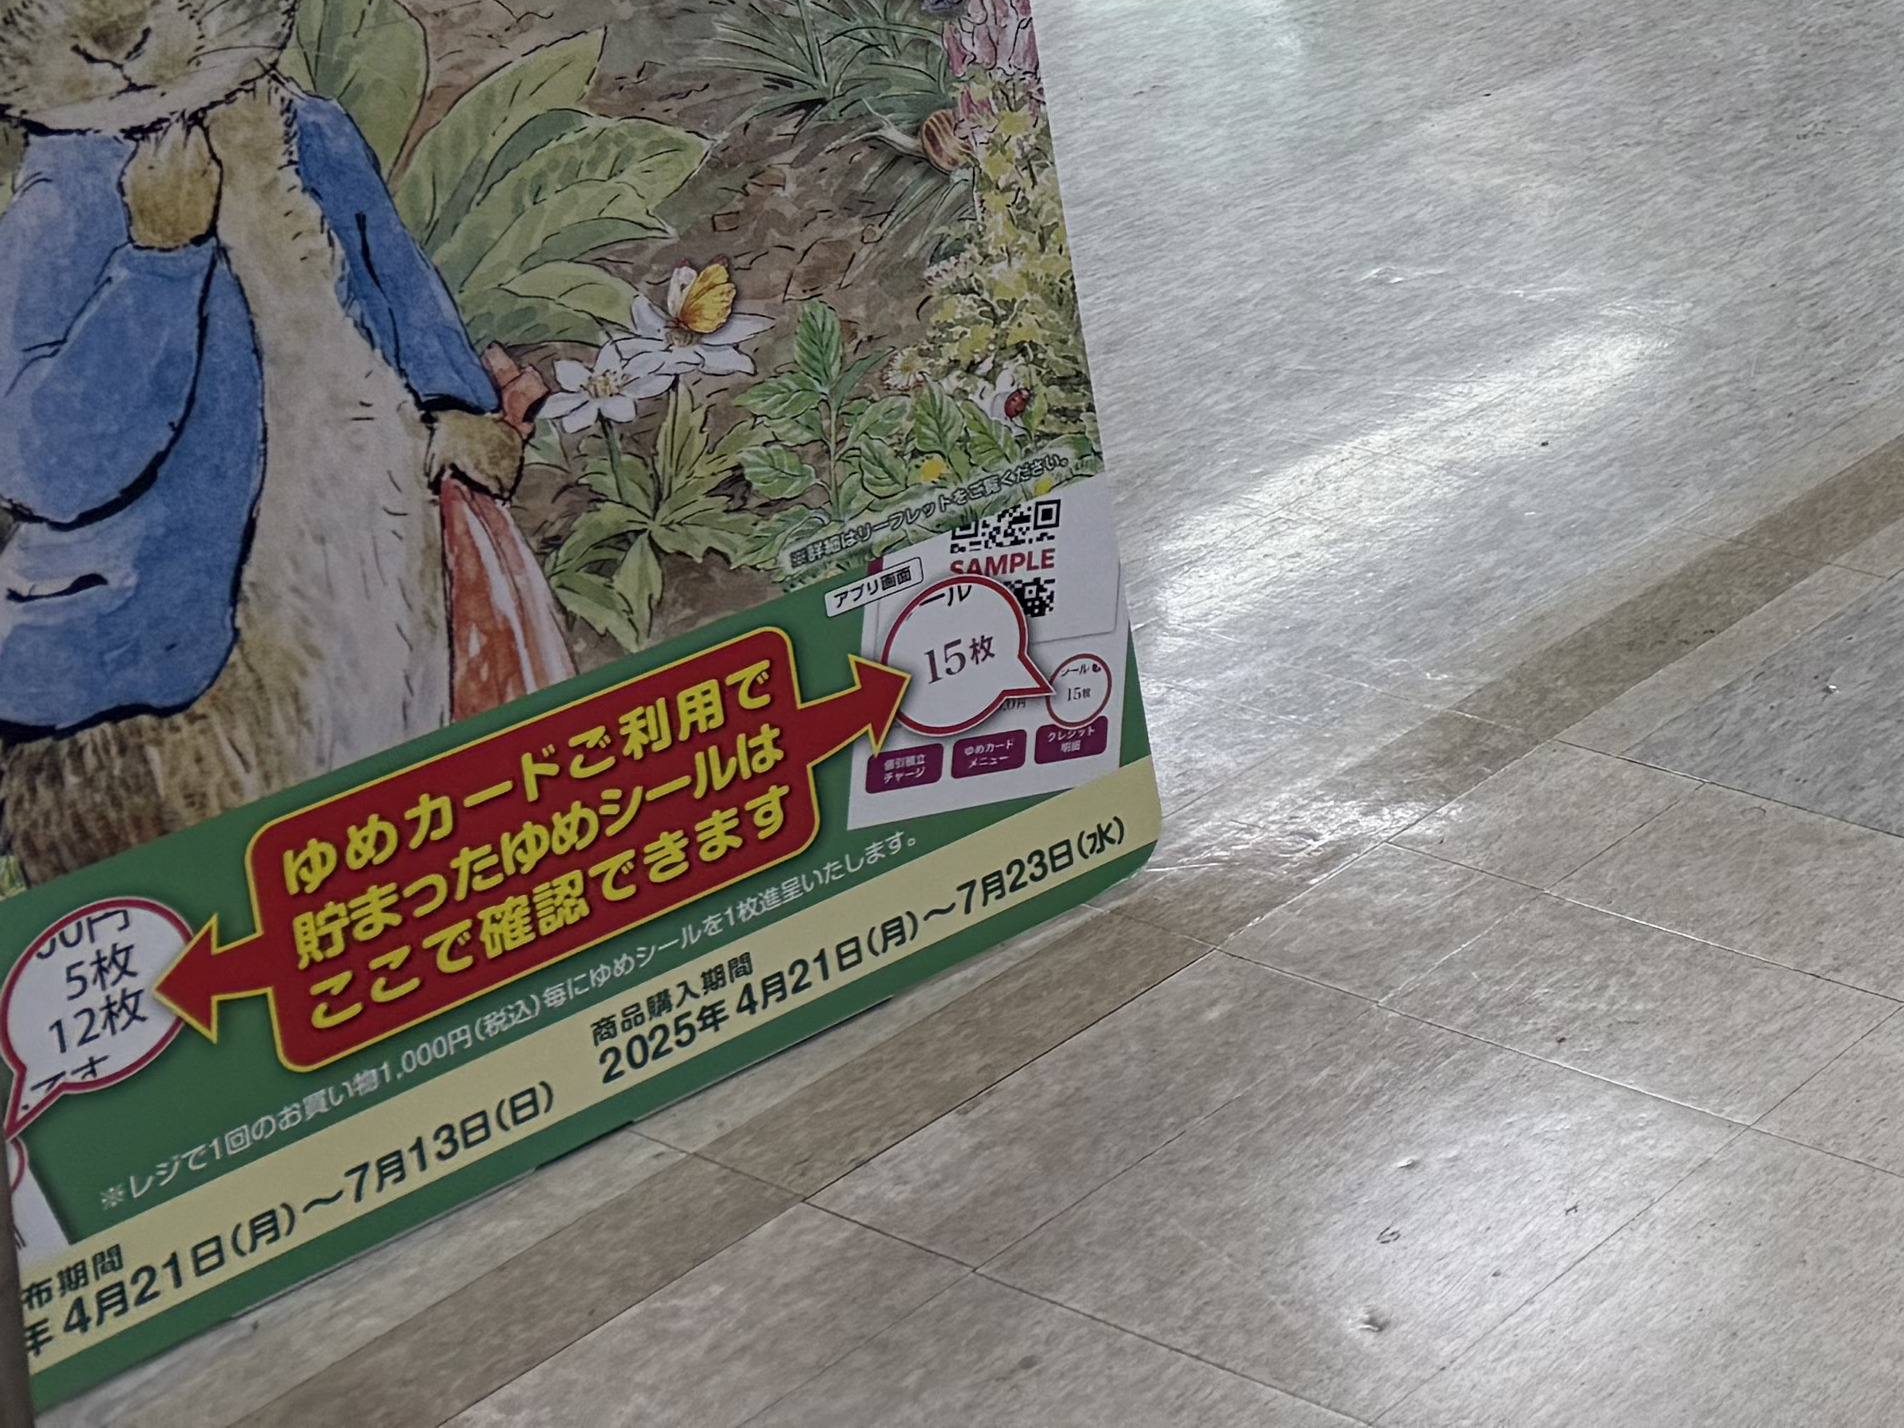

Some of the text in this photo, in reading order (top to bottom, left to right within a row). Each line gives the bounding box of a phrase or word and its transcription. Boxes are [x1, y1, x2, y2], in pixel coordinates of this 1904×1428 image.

[949, 548, 1057, 576] SAMPLE
[832, 567, 913, 610] アプリ画面
[923, 635, 996, 686] 15枚
[1066, 686, 1091, 703] 15枚
[964, 741, 1015, 757] ゆめカード
[1047, 726, 1096, 743] クレジット
[283, 659, 772, 896] ゆめカードご利用で
[882, 767, 926, 784] チャージ
[968, 753, 1010, 769] メニュー
[293, 723, 784, 972] 貯まったゆめシールは
[309, 784, 791, 1031] ここで確認できます
[65, 941, 140, 1002] 5枚
[48, 987, 151, 1055] 12枚
[590, 951, 754, 1047] 商品購入期間
[599, 1002, 730, 1085] 2025年
